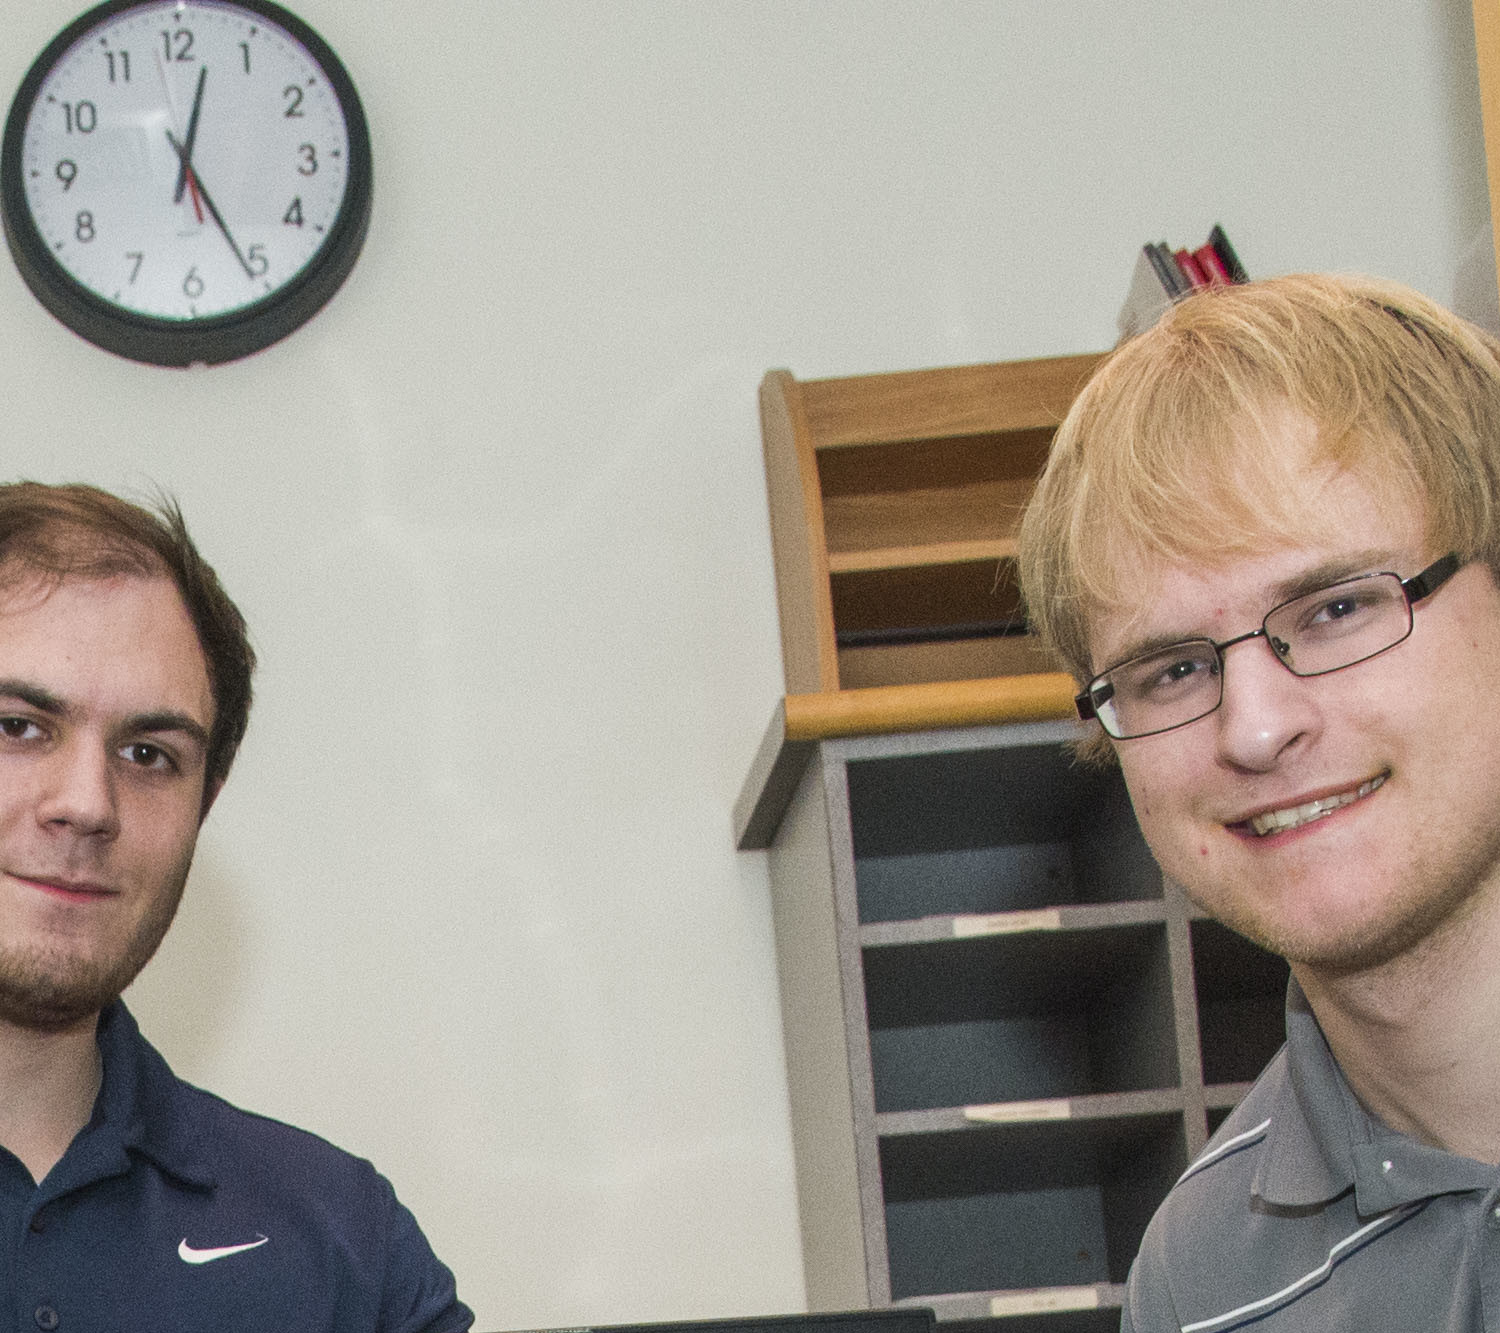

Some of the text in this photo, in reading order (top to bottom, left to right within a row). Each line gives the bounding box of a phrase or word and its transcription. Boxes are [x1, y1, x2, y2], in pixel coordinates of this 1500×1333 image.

[161, 29, 196, 63] 12
[238, 42, 251, 75] 1
[104, 51, 132, 83] 11
[62, 101, 97, 134] 10
[283, 85, 305, 118] 2
[55, 159, 78, 191] 9
[297, 144, 319, 176] 3
[75, 210, 96, 243] 8
[283, 197, 305, 228] 4
[124, 252, 145, 285] 7
[247, 244, 270, 277] 5
[182, 267, 205, 299] 6
